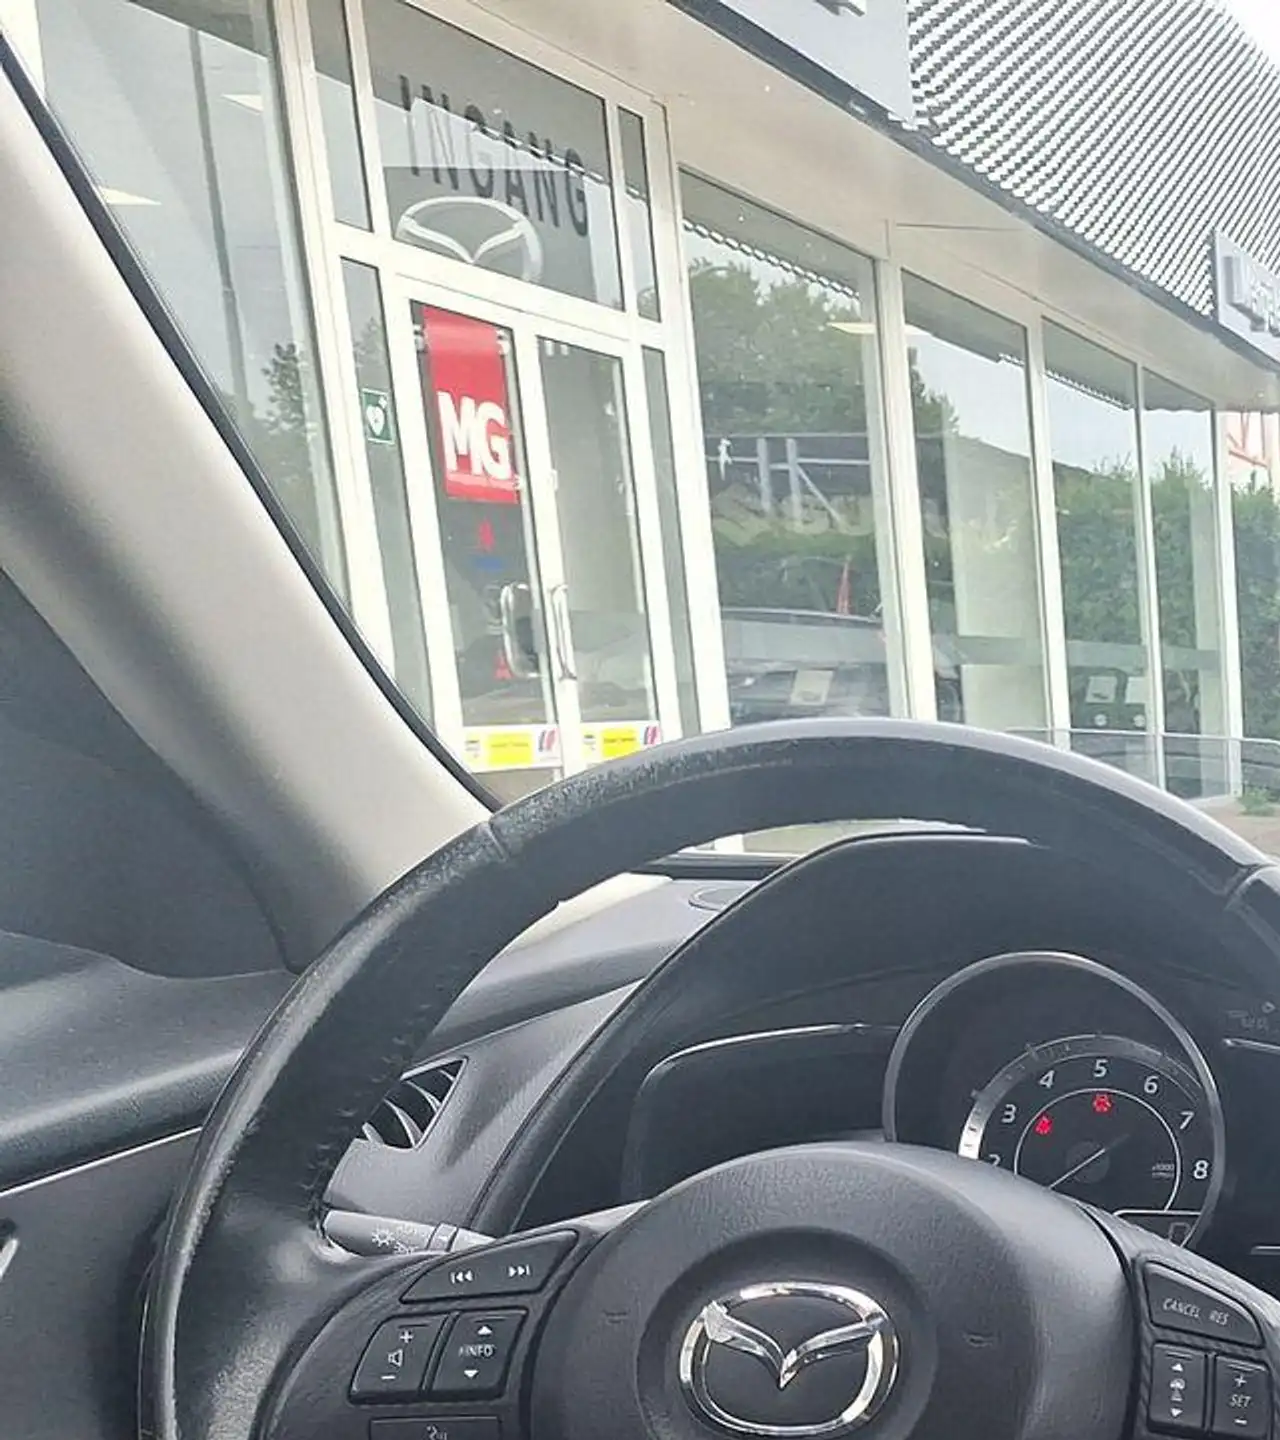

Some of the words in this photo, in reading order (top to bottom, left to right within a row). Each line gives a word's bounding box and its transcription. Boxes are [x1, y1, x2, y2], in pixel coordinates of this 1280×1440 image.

[398, 74, 588, 238] INGANG
[437, 389, 513, 480] MG
[1093, 1059, 1108, 1078] 5
[1038, 1070, 1055, 1088] 4
[1143, 1074, 1159, 1094] 6
[1001, 1103, 1017, 1123] 3
[1179, 1111, 1195, 1130] 7
[1193, 1160, 1209, 1179] 8
